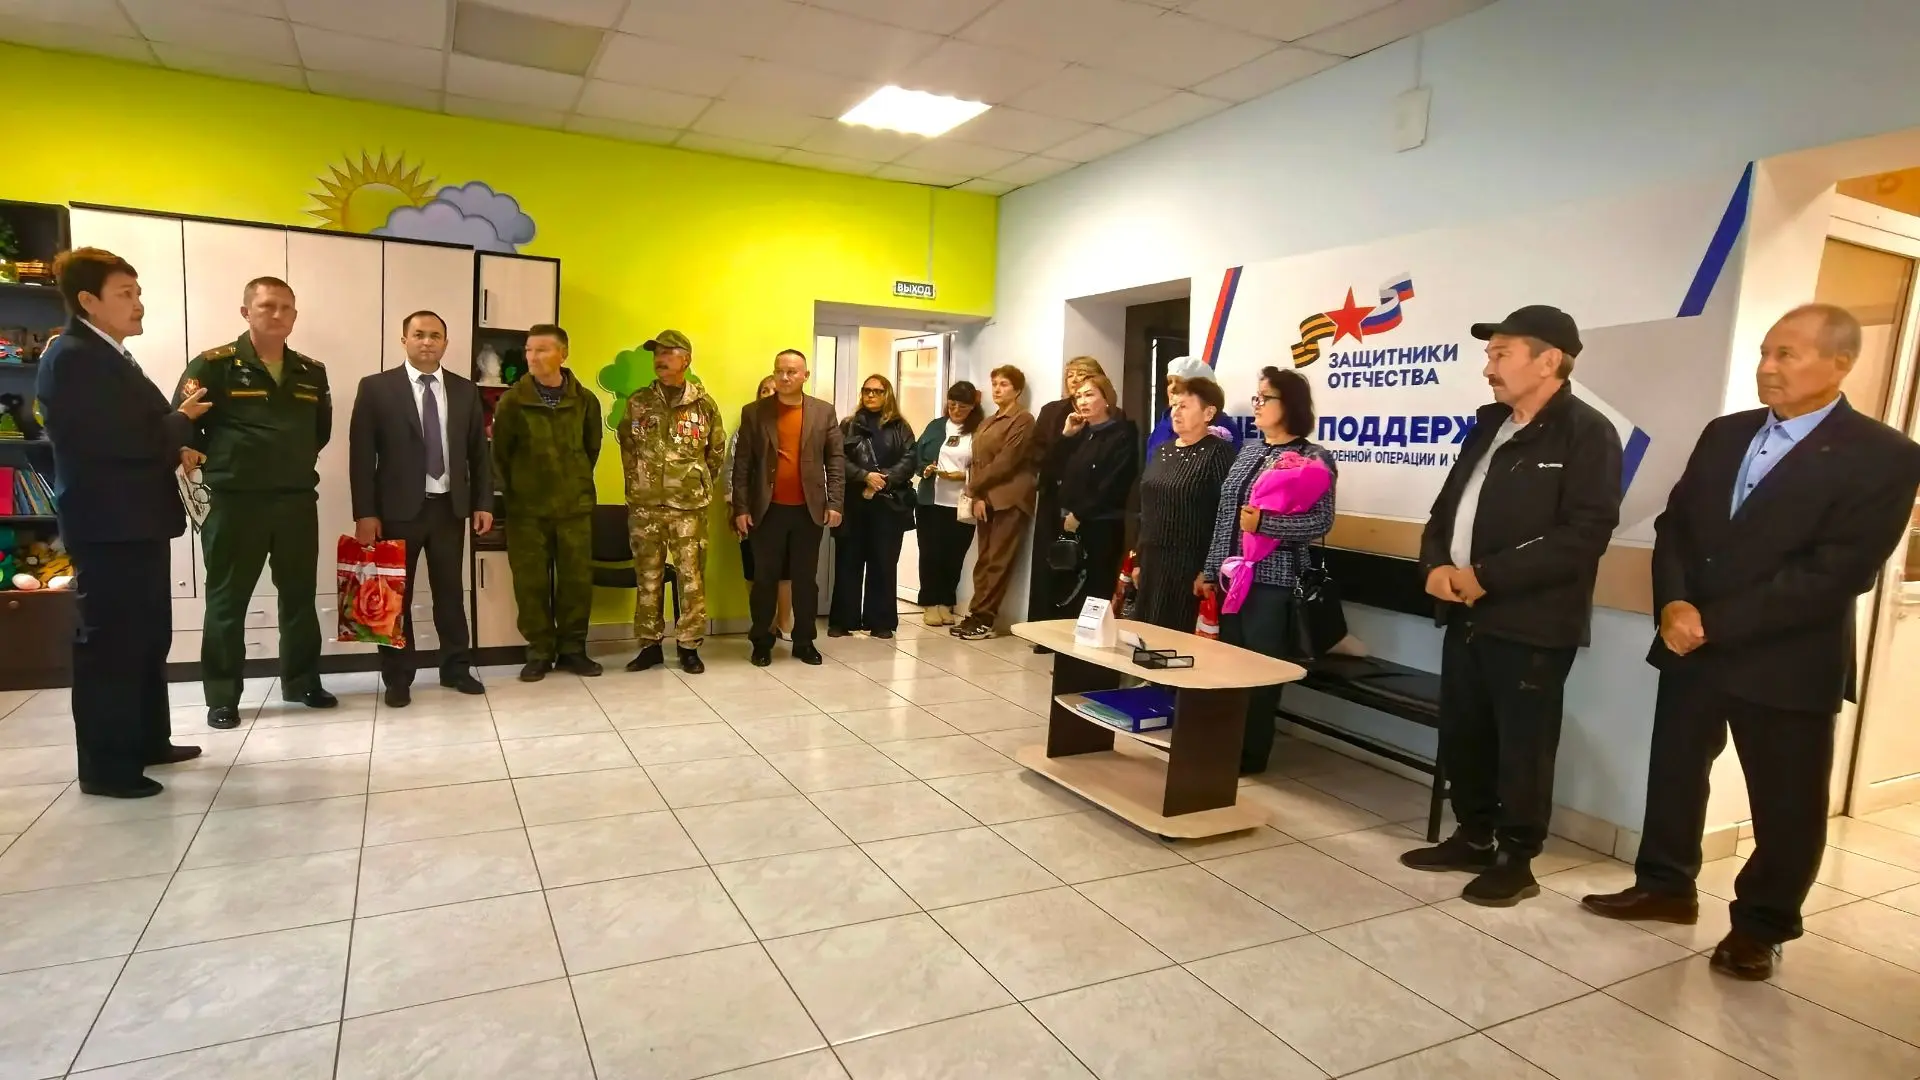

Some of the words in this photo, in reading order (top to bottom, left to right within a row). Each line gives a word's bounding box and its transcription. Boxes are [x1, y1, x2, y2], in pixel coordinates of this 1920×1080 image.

[897, 283, 932, 296] ВЫХОД
[1328, 343, 1458, 368] ЗАЩИТНИКИ
[1327, 368, 1440, 388] ОТЕЧЕСТВА
[1332, 448, 1372, 463] ОЕННОЙ
[1375, 451, 1436, 467] ОПЕРАЦИИ
[1440, 453, 1448, 466] И
